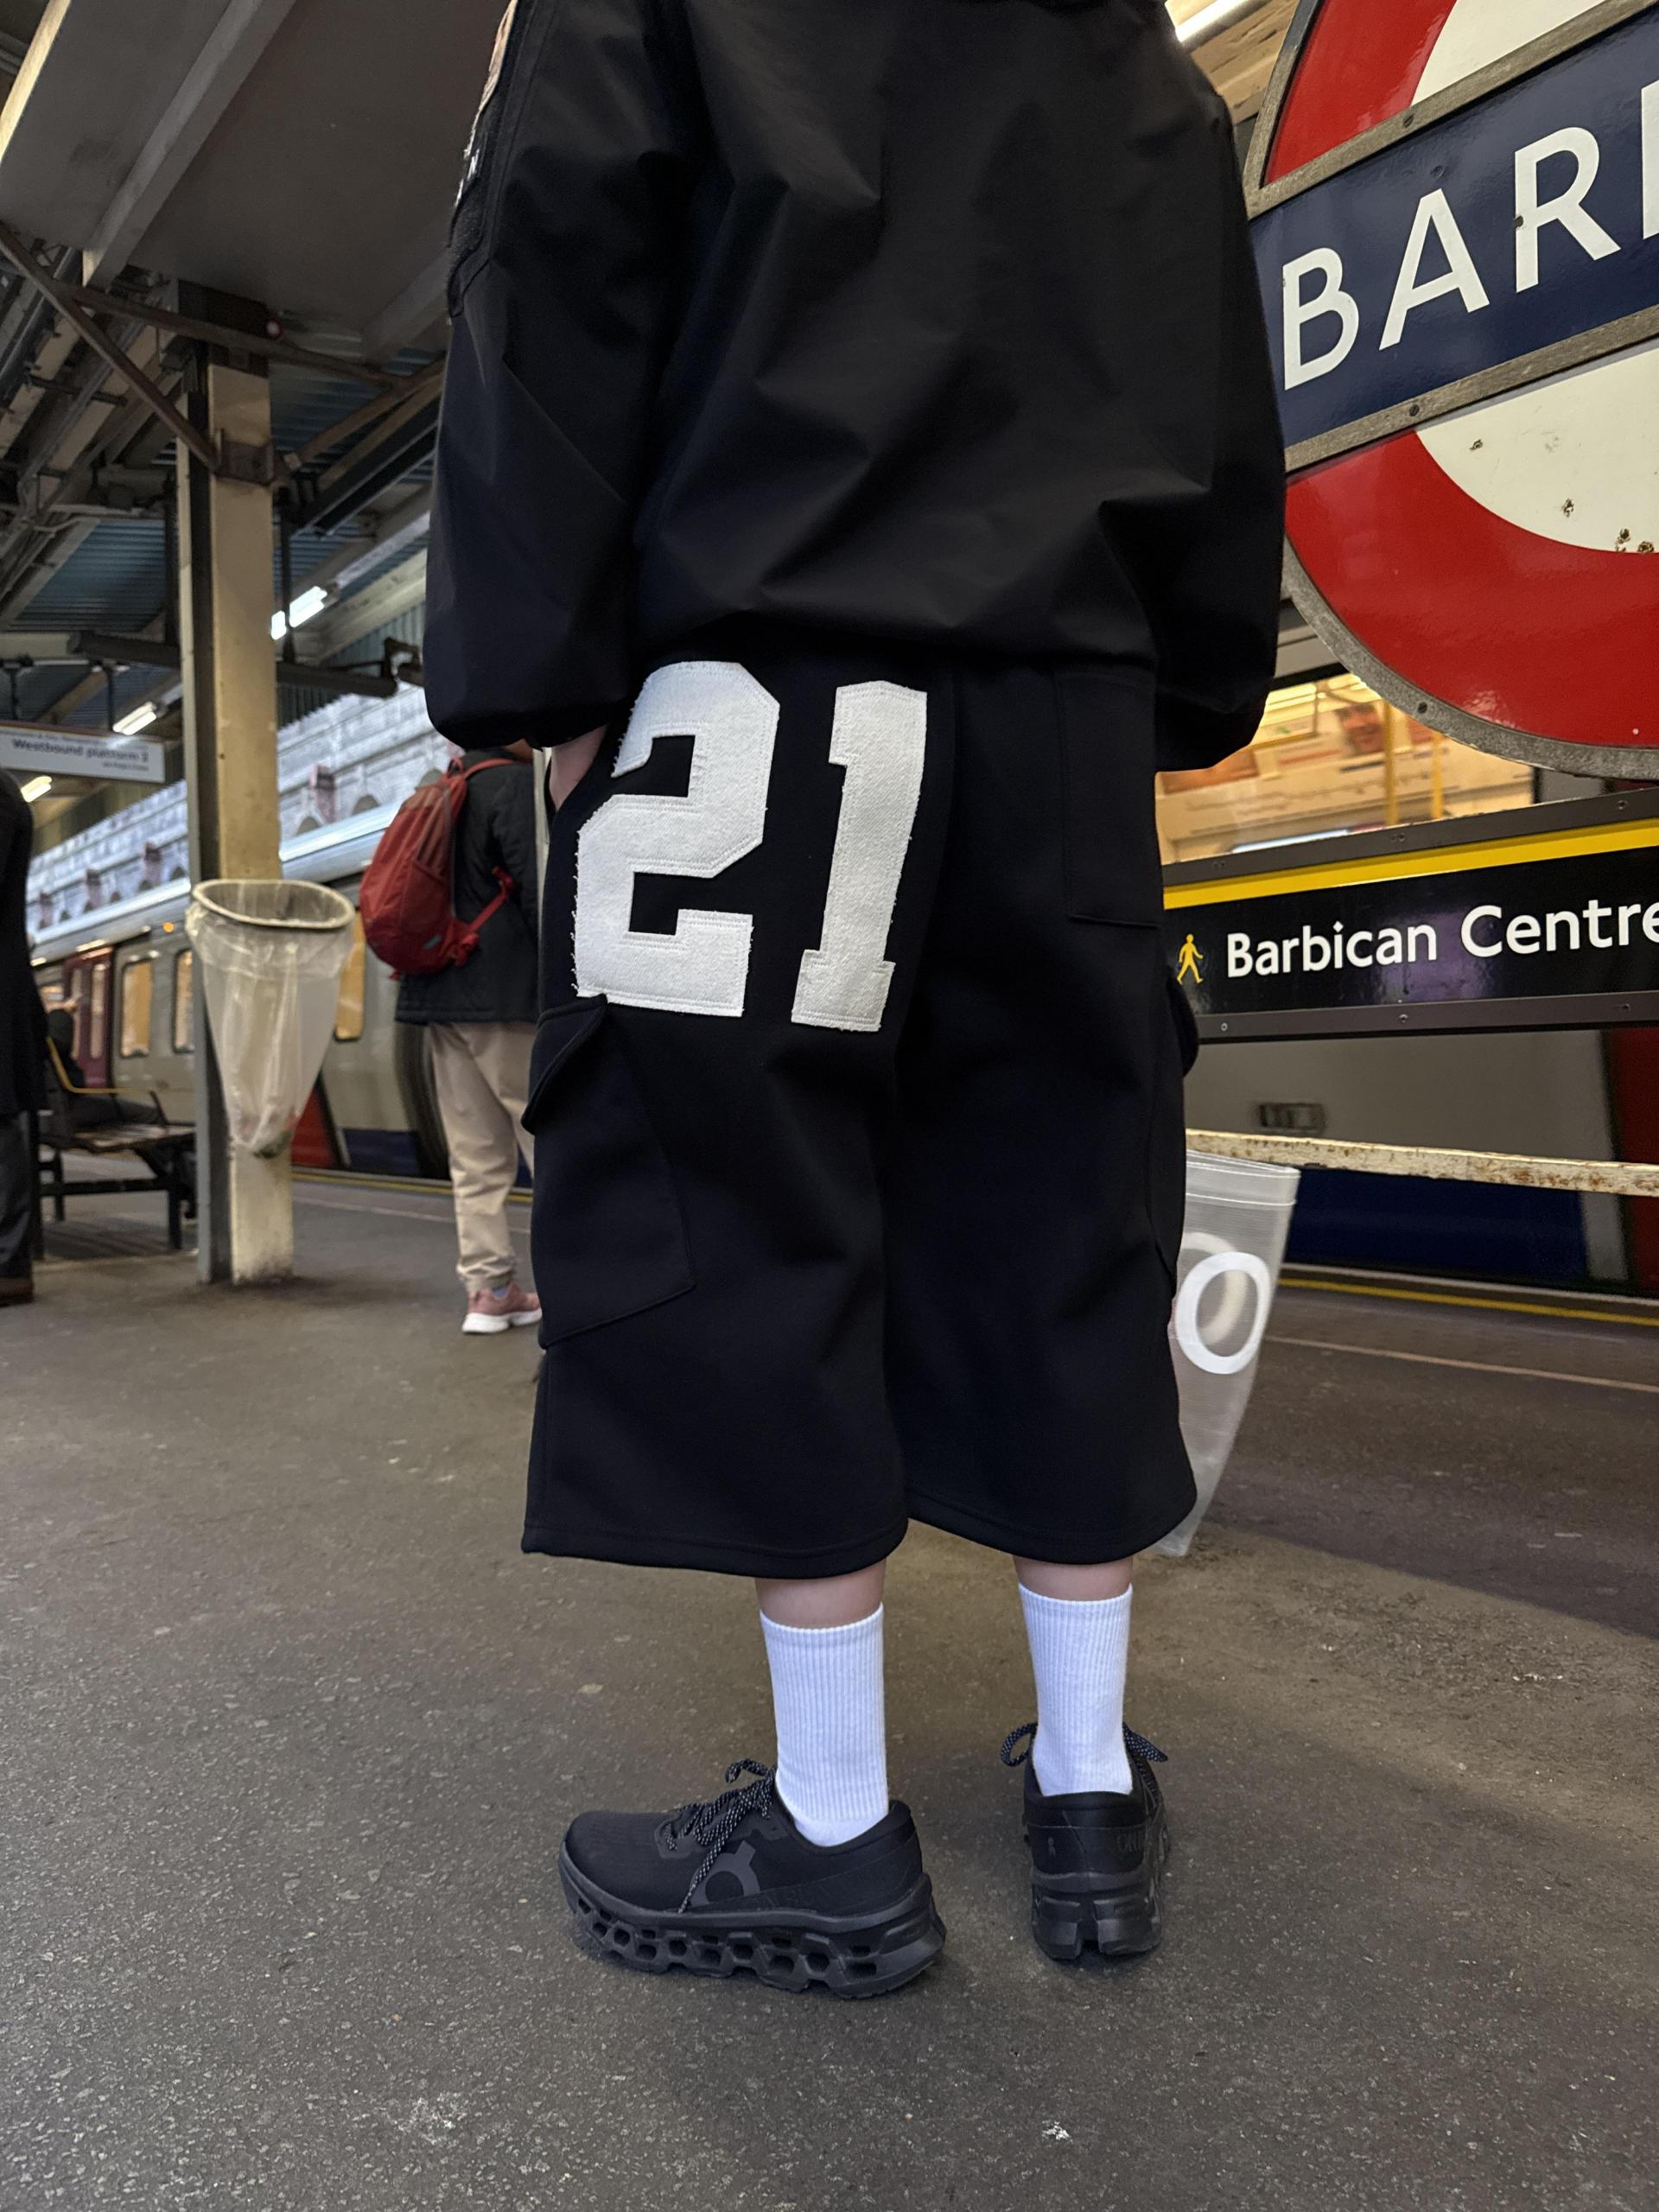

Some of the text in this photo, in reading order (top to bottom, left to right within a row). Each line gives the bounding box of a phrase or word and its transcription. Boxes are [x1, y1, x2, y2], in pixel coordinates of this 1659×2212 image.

[1282, 80, 1659, 391] BAR
[12, 738, 84, 756] Westbound
[86, 747, 139, 760] platform
[571, 660, 928, 1033] 21
[1227, 920, 1437, 978] Barbican
